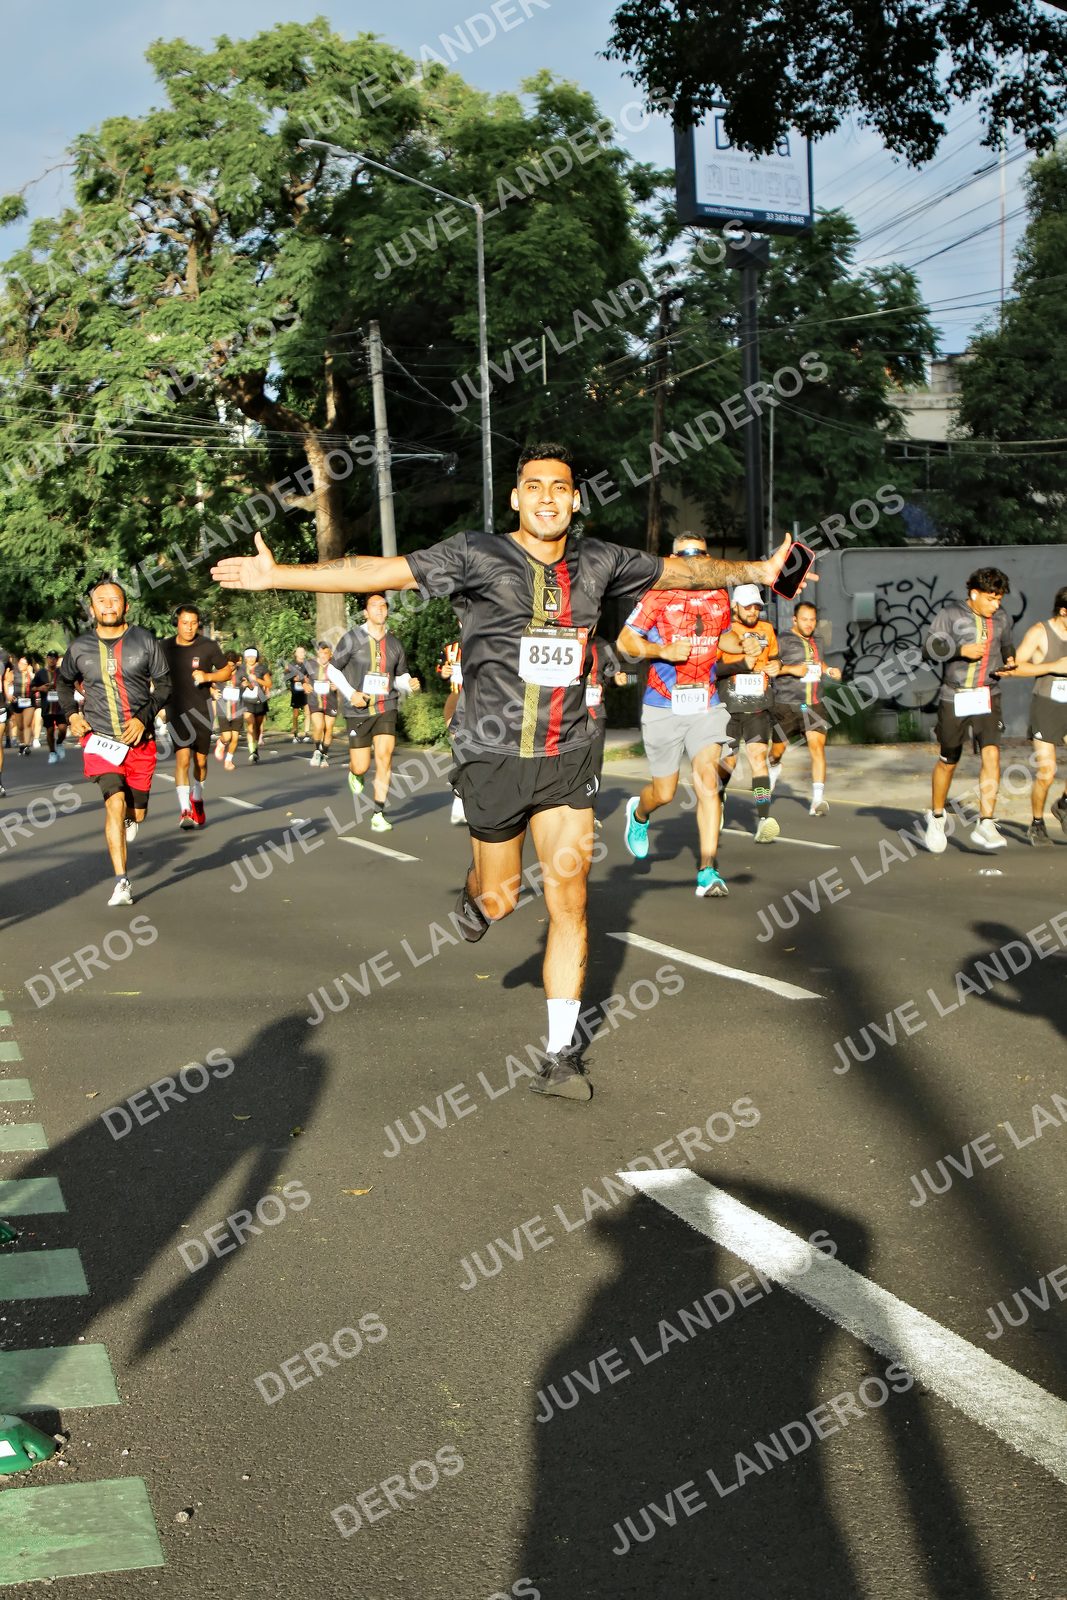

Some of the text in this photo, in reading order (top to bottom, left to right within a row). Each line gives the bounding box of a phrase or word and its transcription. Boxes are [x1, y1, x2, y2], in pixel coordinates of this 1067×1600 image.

[876, 575, 938, 599] TOY
[528, 645, 574, 666] 8545
[95, 739, 121, 752] 1017
